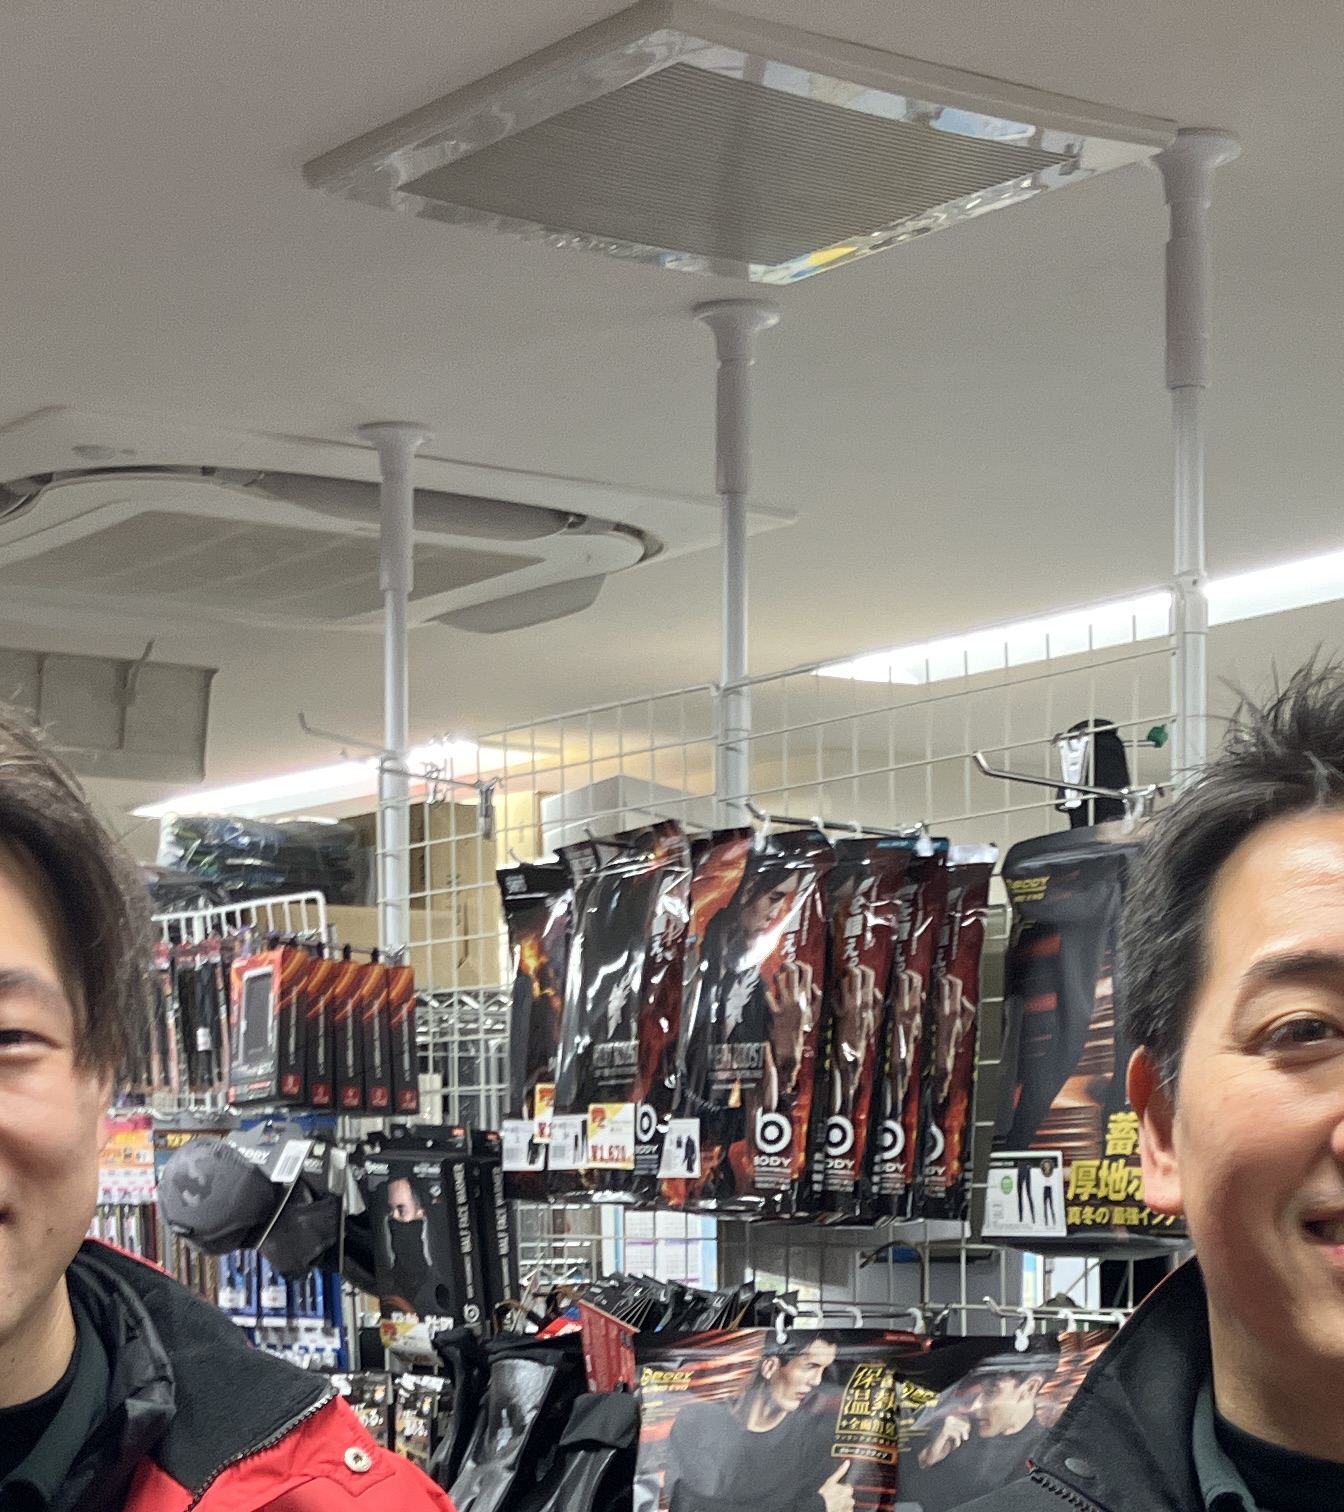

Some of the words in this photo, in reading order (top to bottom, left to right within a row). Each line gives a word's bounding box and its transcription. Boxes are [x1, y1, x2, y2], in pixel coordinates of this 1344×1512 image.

[1105, 1111, 1140, 1155] 蓄
[825, 1159, 855, 1169] ODY
[460, 1230, 472, 1254] HALF
